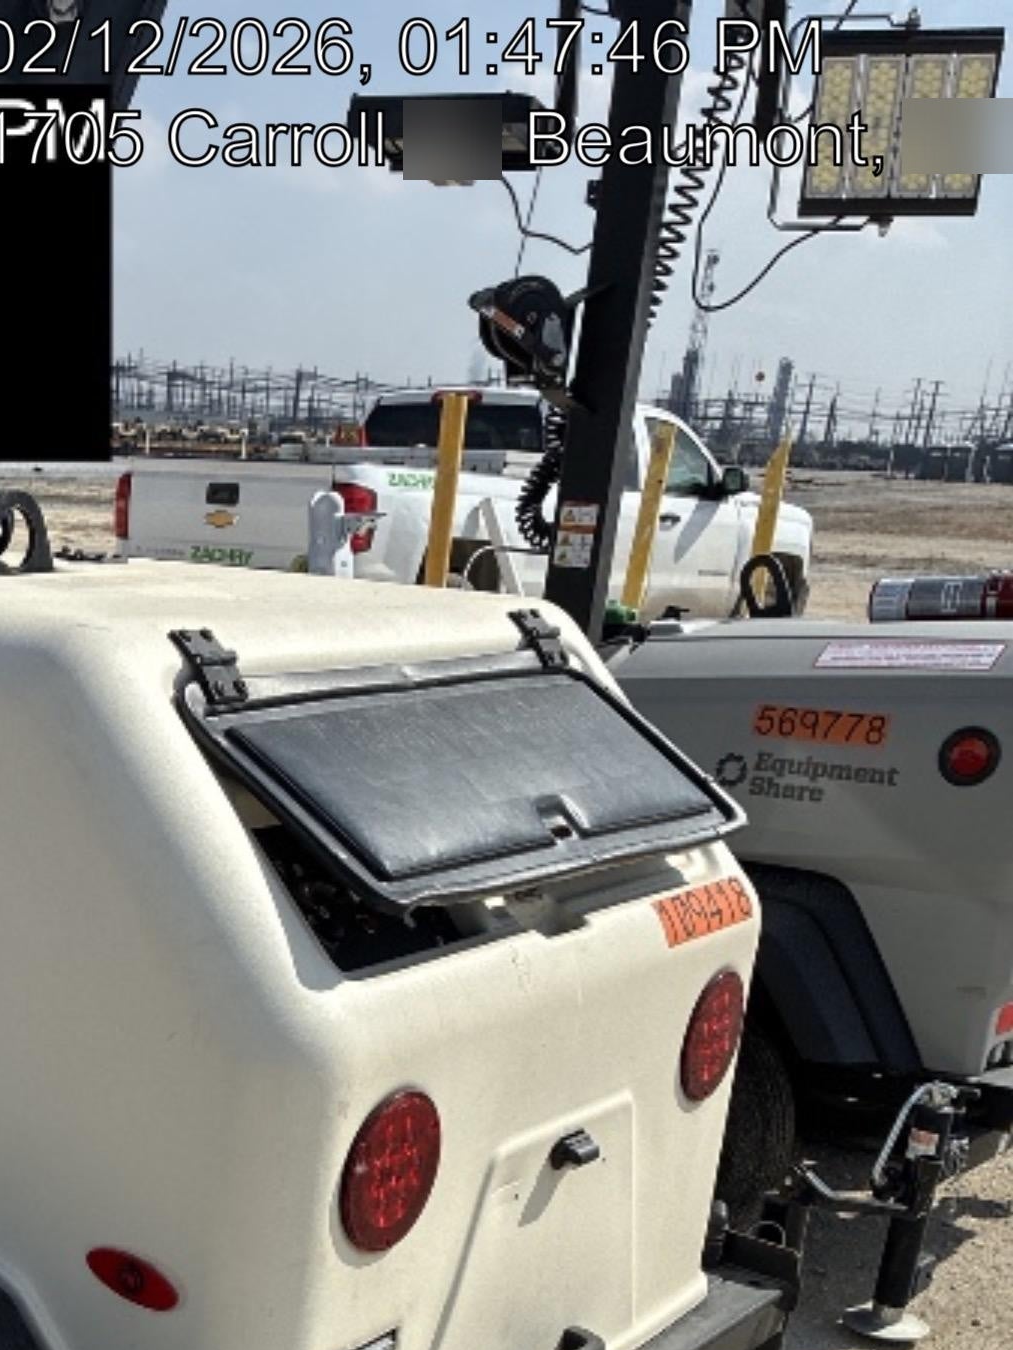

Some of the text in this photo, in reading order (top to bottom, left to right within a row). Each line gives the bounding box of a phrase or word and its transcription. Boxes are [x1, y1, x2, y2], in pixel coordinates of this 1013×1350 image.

[754, 704, 887, 746] 569778
[754, 752, 900, 787] Equipment
[749, 776, 825, 802] Share
